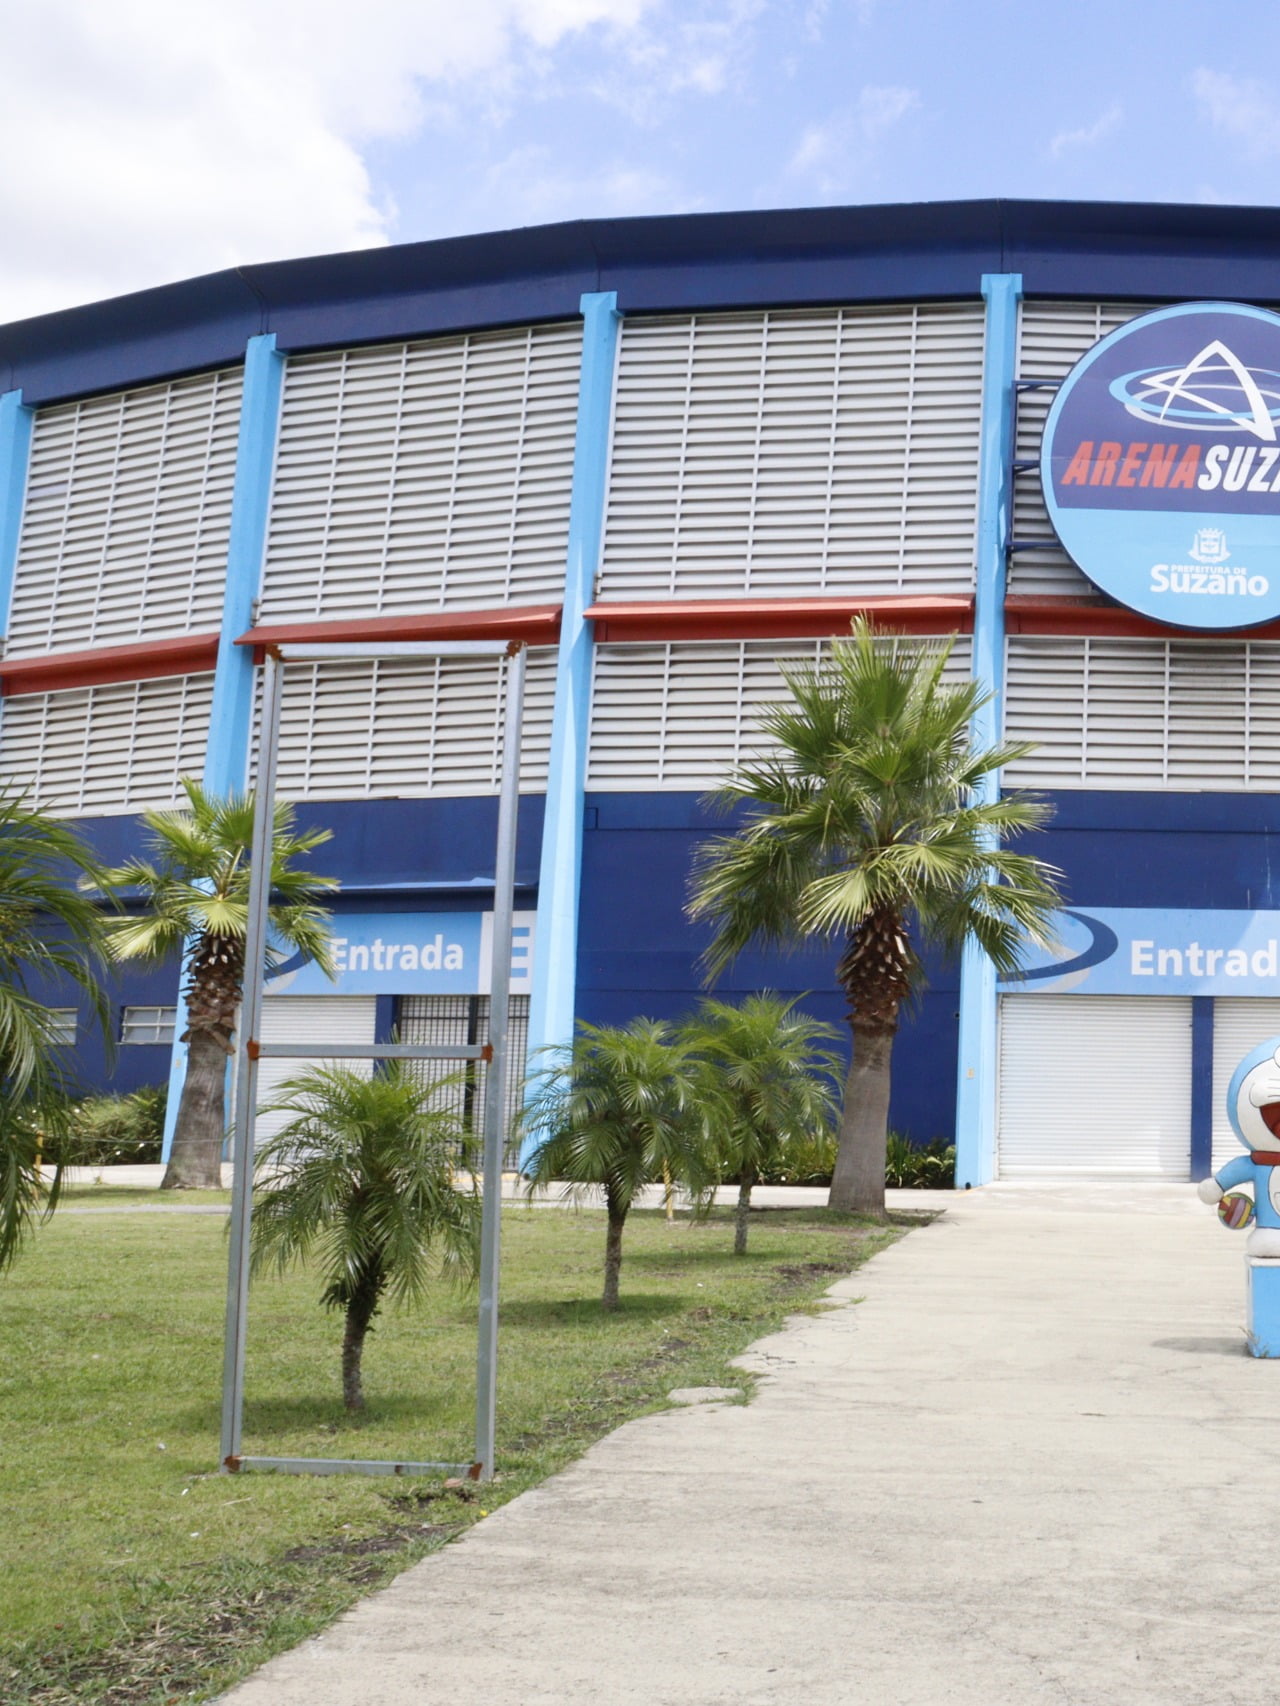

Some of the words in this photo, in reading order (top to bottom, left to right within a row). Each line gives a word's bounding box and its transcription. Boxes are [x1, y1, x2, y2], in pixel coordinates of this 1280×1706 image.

[1150, 564, 1269, 596] Suzano
[1171, 564, 1230, 575] PREFEITURA
[1233, 567, 1247, 575] DE
[329, 934, 464, 971] Entrada
